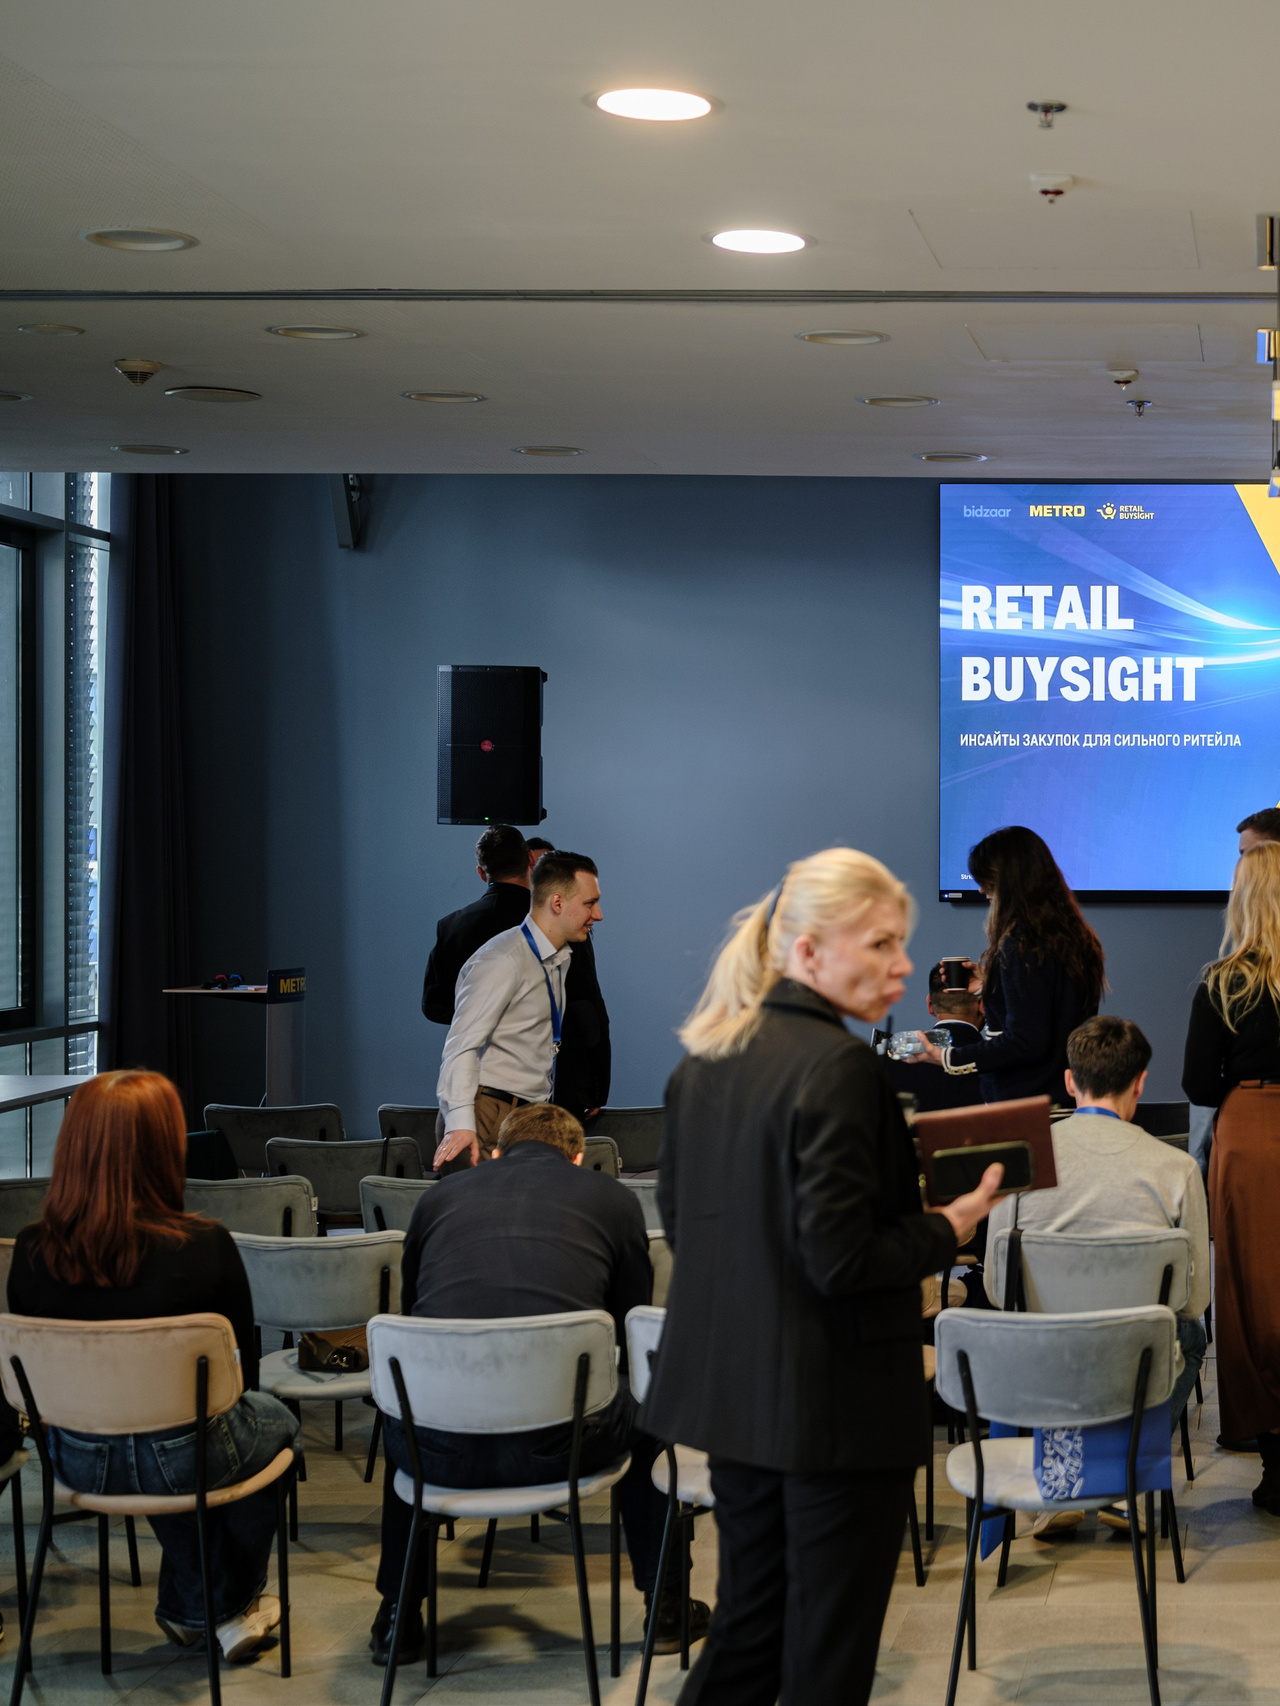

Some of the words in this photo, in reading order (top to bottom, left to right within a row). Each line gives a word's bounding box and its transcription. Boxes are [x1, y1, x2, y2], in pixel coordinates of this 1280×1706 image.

[963, 505, 1011, 518] bidzaar
[1029, 505, 1085, 517] METRO
[961, 585, 1134, 630] RETAIL
[961, 656, 1204, 702] BUYSIGHT
[960, 731, 1020, 746] ИНСАЙТЫ
[1022, 734, 1080, 746] ЗАКУПОК
[1083, 734, 1111, 748] ДЛЯ
[1113, 734, 1180, 746] СИЛЬНОГО
[1183, 731, 1241, 746] РИТЕЙЛА
